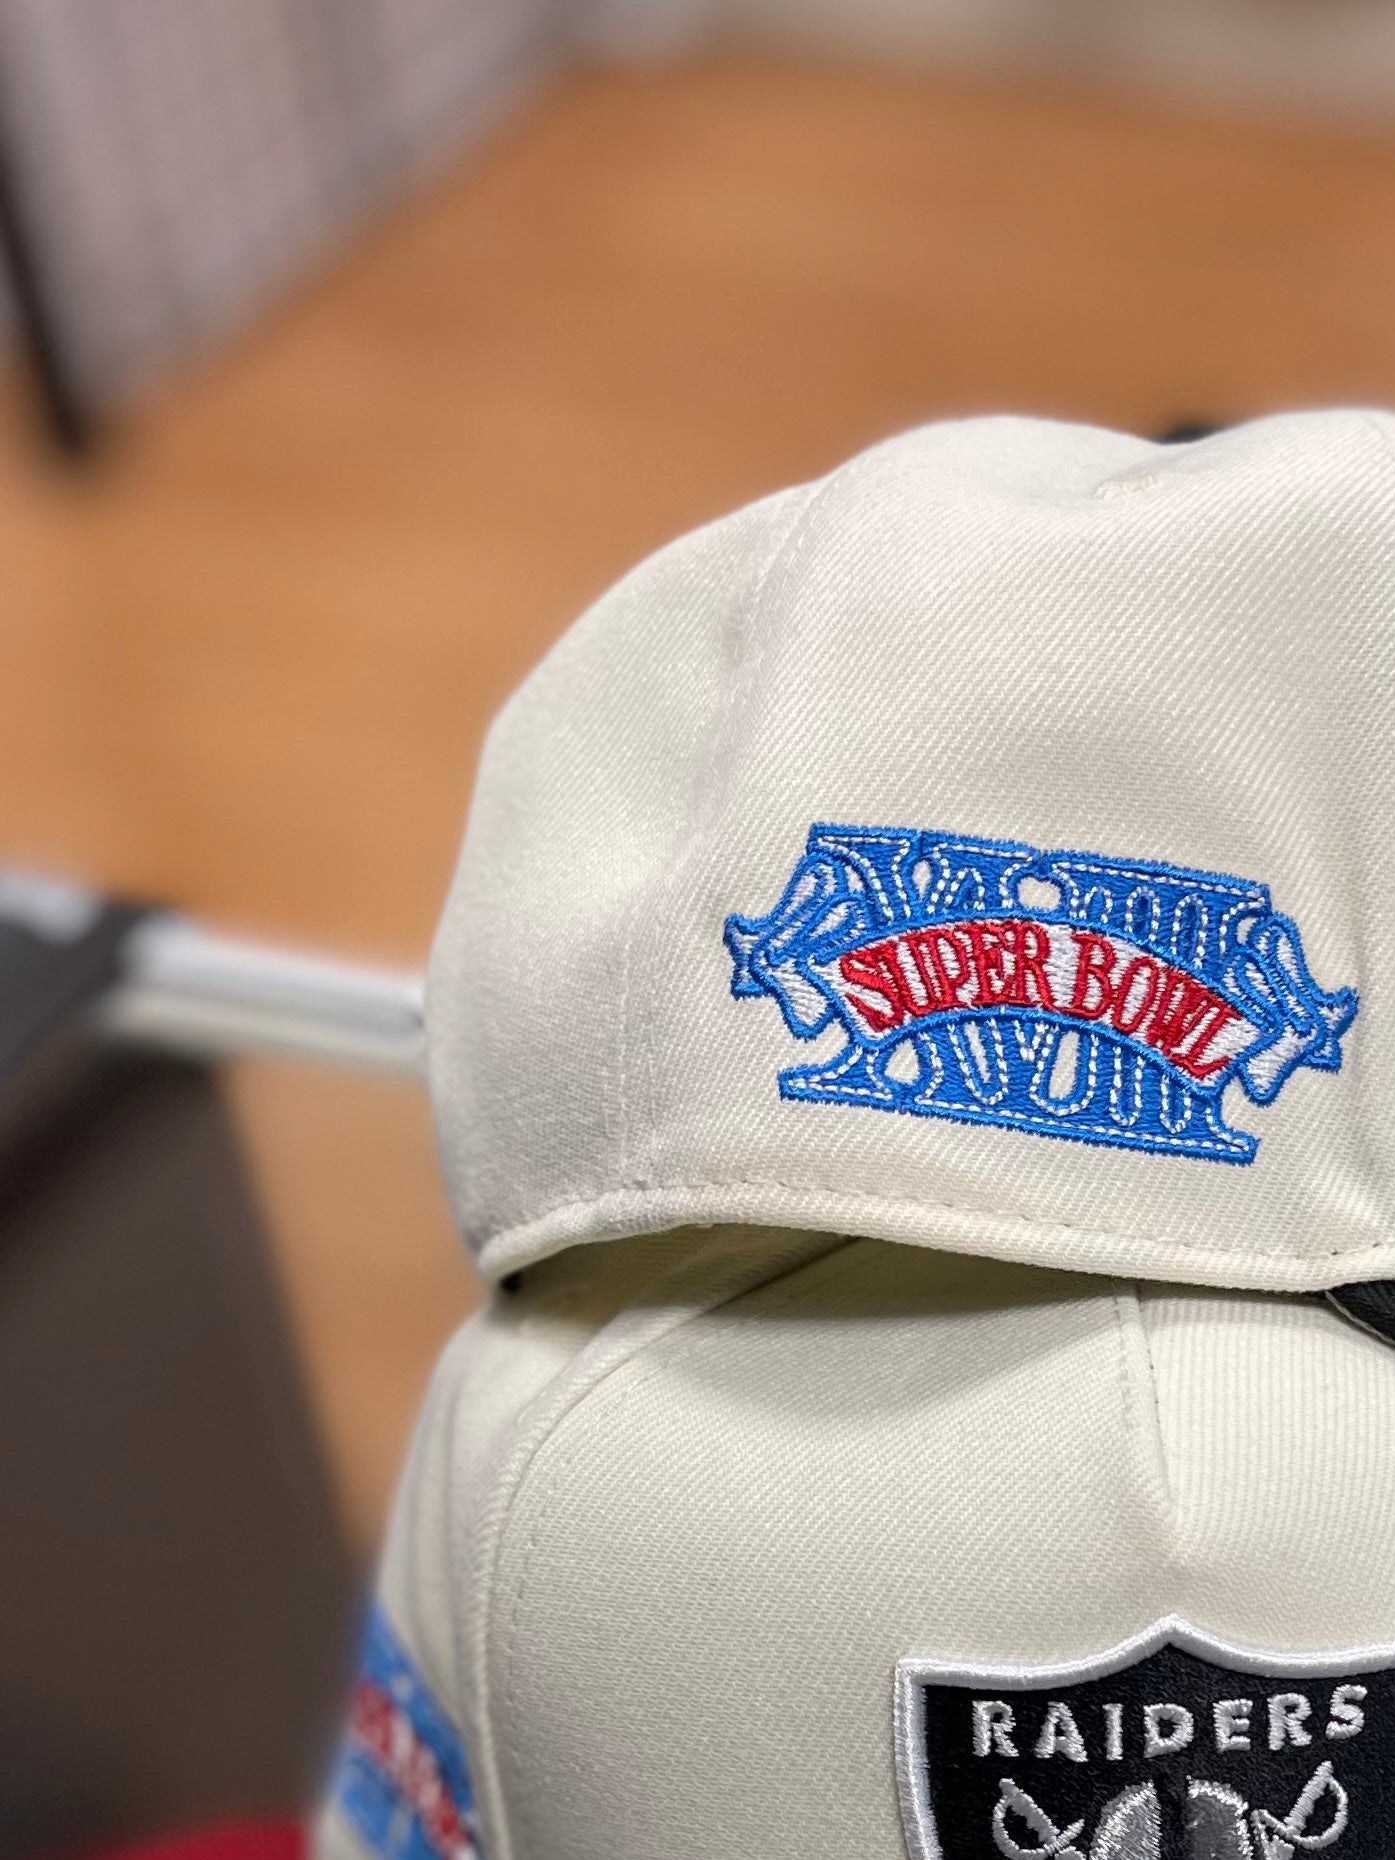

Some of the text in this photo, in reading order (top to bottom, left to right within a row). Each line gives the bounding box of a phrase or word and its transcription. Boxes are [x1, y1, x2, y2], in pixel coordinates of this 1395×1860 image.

[839, 918, 1243, 1079] SUPER BOWL
[971, 1683, 1369, 1763] RAIDERS
